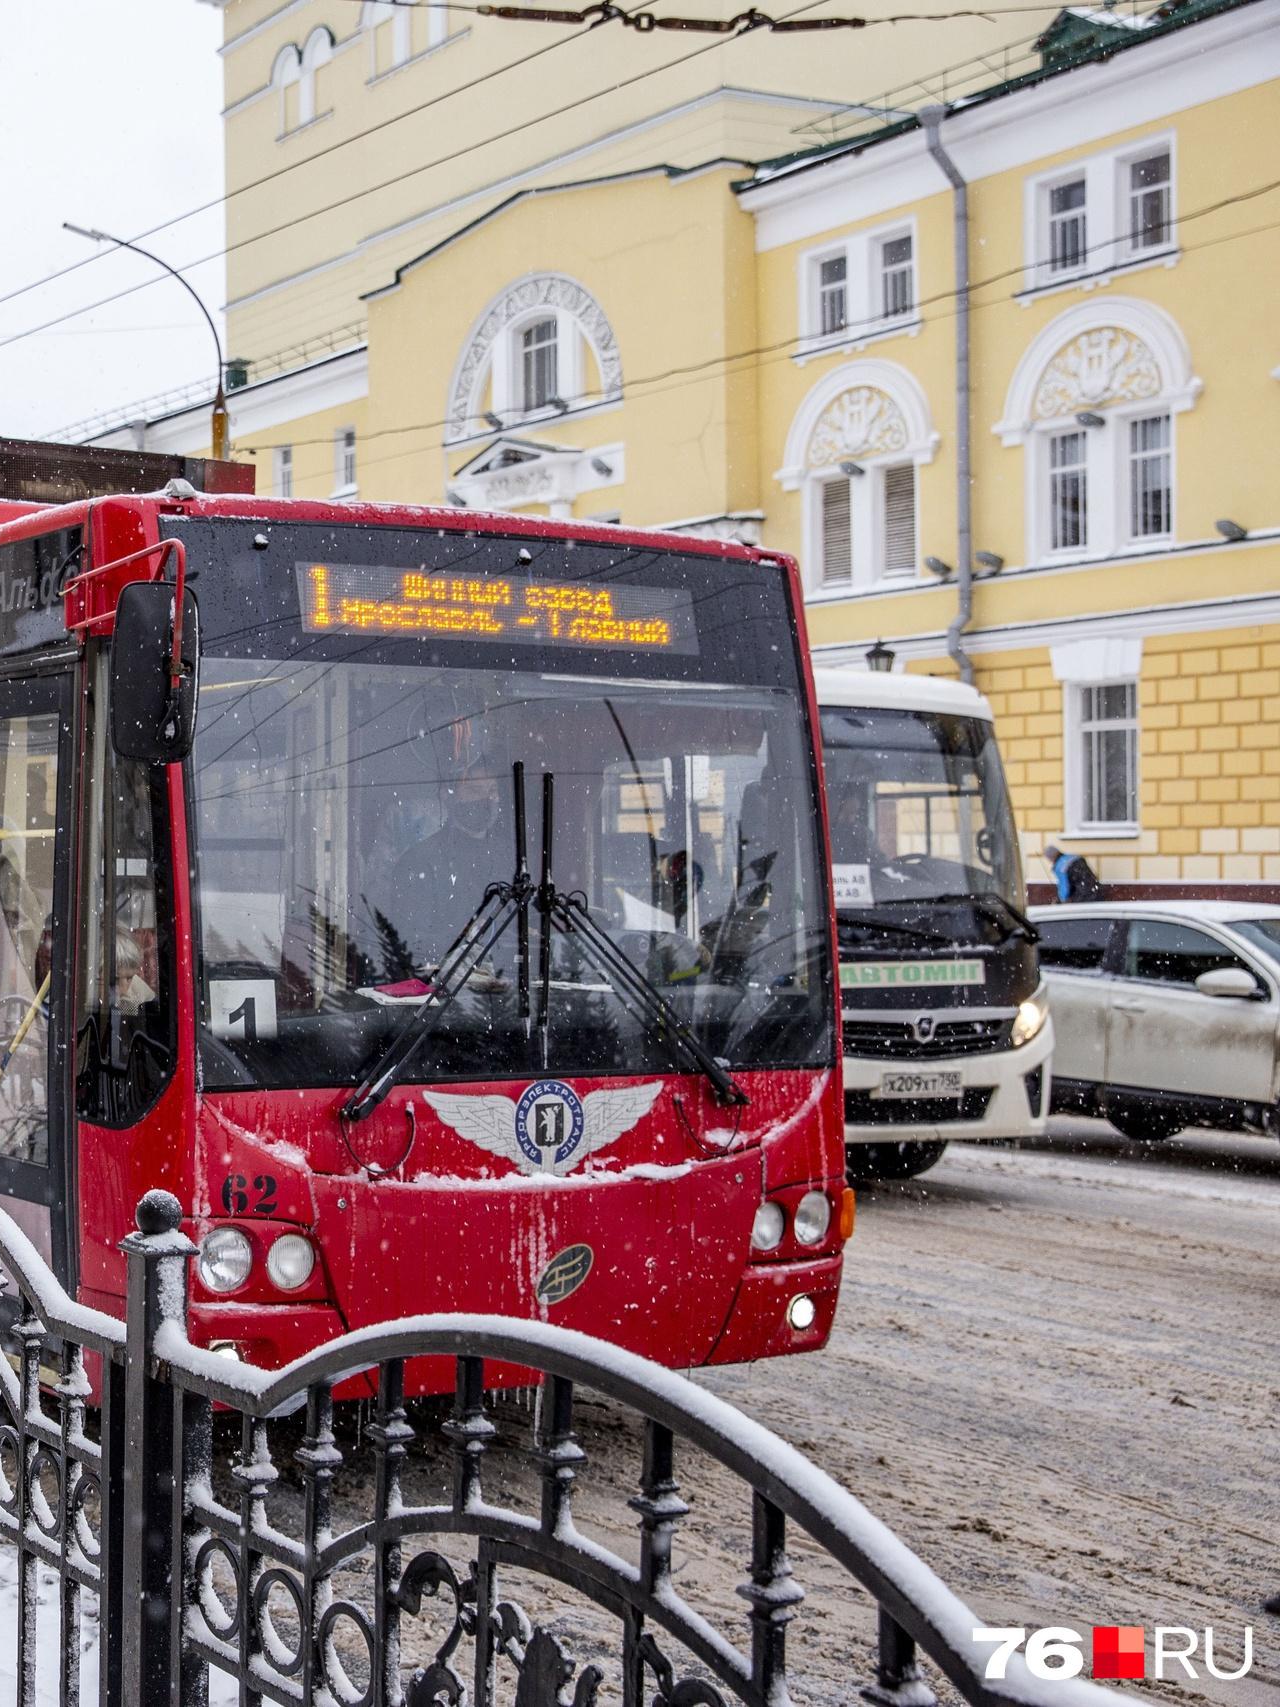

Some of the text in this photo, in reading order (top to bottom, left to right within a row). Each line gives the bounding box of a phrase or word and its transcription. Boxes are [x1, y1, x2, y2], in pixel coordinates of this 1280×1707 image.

[308, 565, 330, 627] 1
[228, 996, 257, 1039] 1
[517, 1083, 583, 1158] ЯРГОРЭЛЕКТРОТРАНС
[221, 1174, 278, 1215] 62
